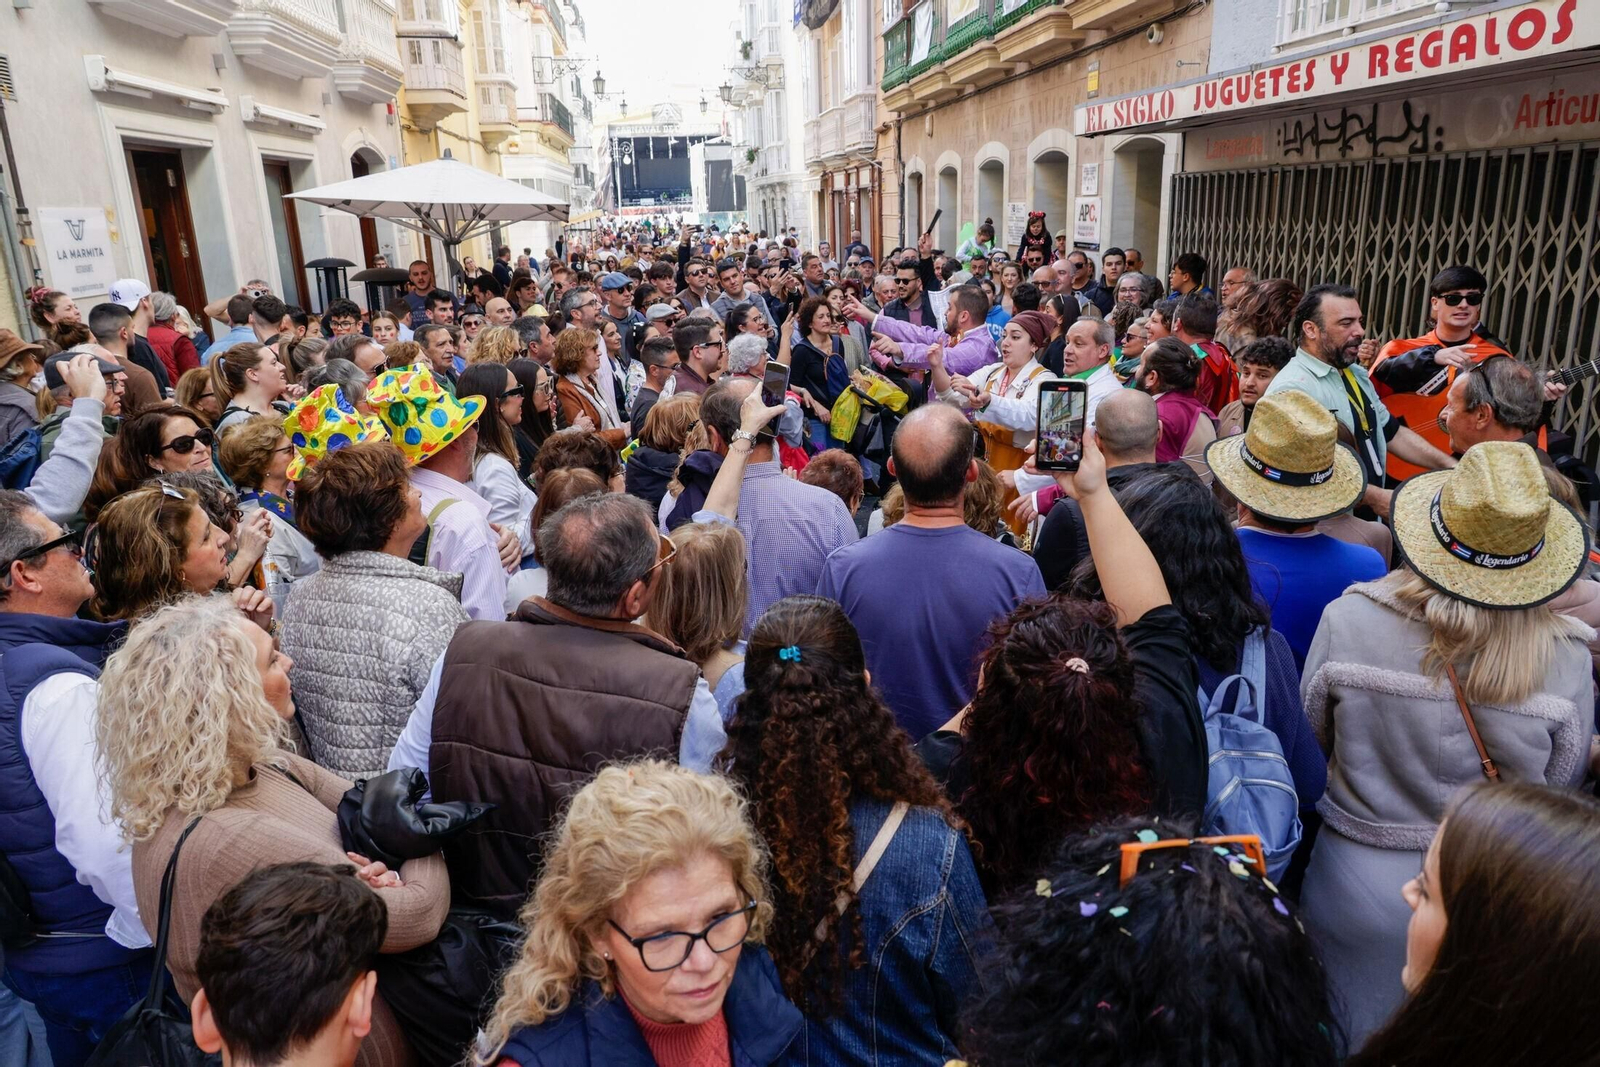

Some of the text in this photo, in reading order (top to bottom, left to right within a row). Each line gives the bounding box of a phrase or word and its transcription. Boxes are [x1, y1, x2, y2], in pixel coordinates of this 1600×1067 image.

[1086, 0, 1578, 132] EL SIGLO JUGUETES Y REGALOS
[1514, 89, 1600, 130] Articu
[57, 247, 104, 260] LA MARMITA
[1481, 553, 1529, 569] Legendario
